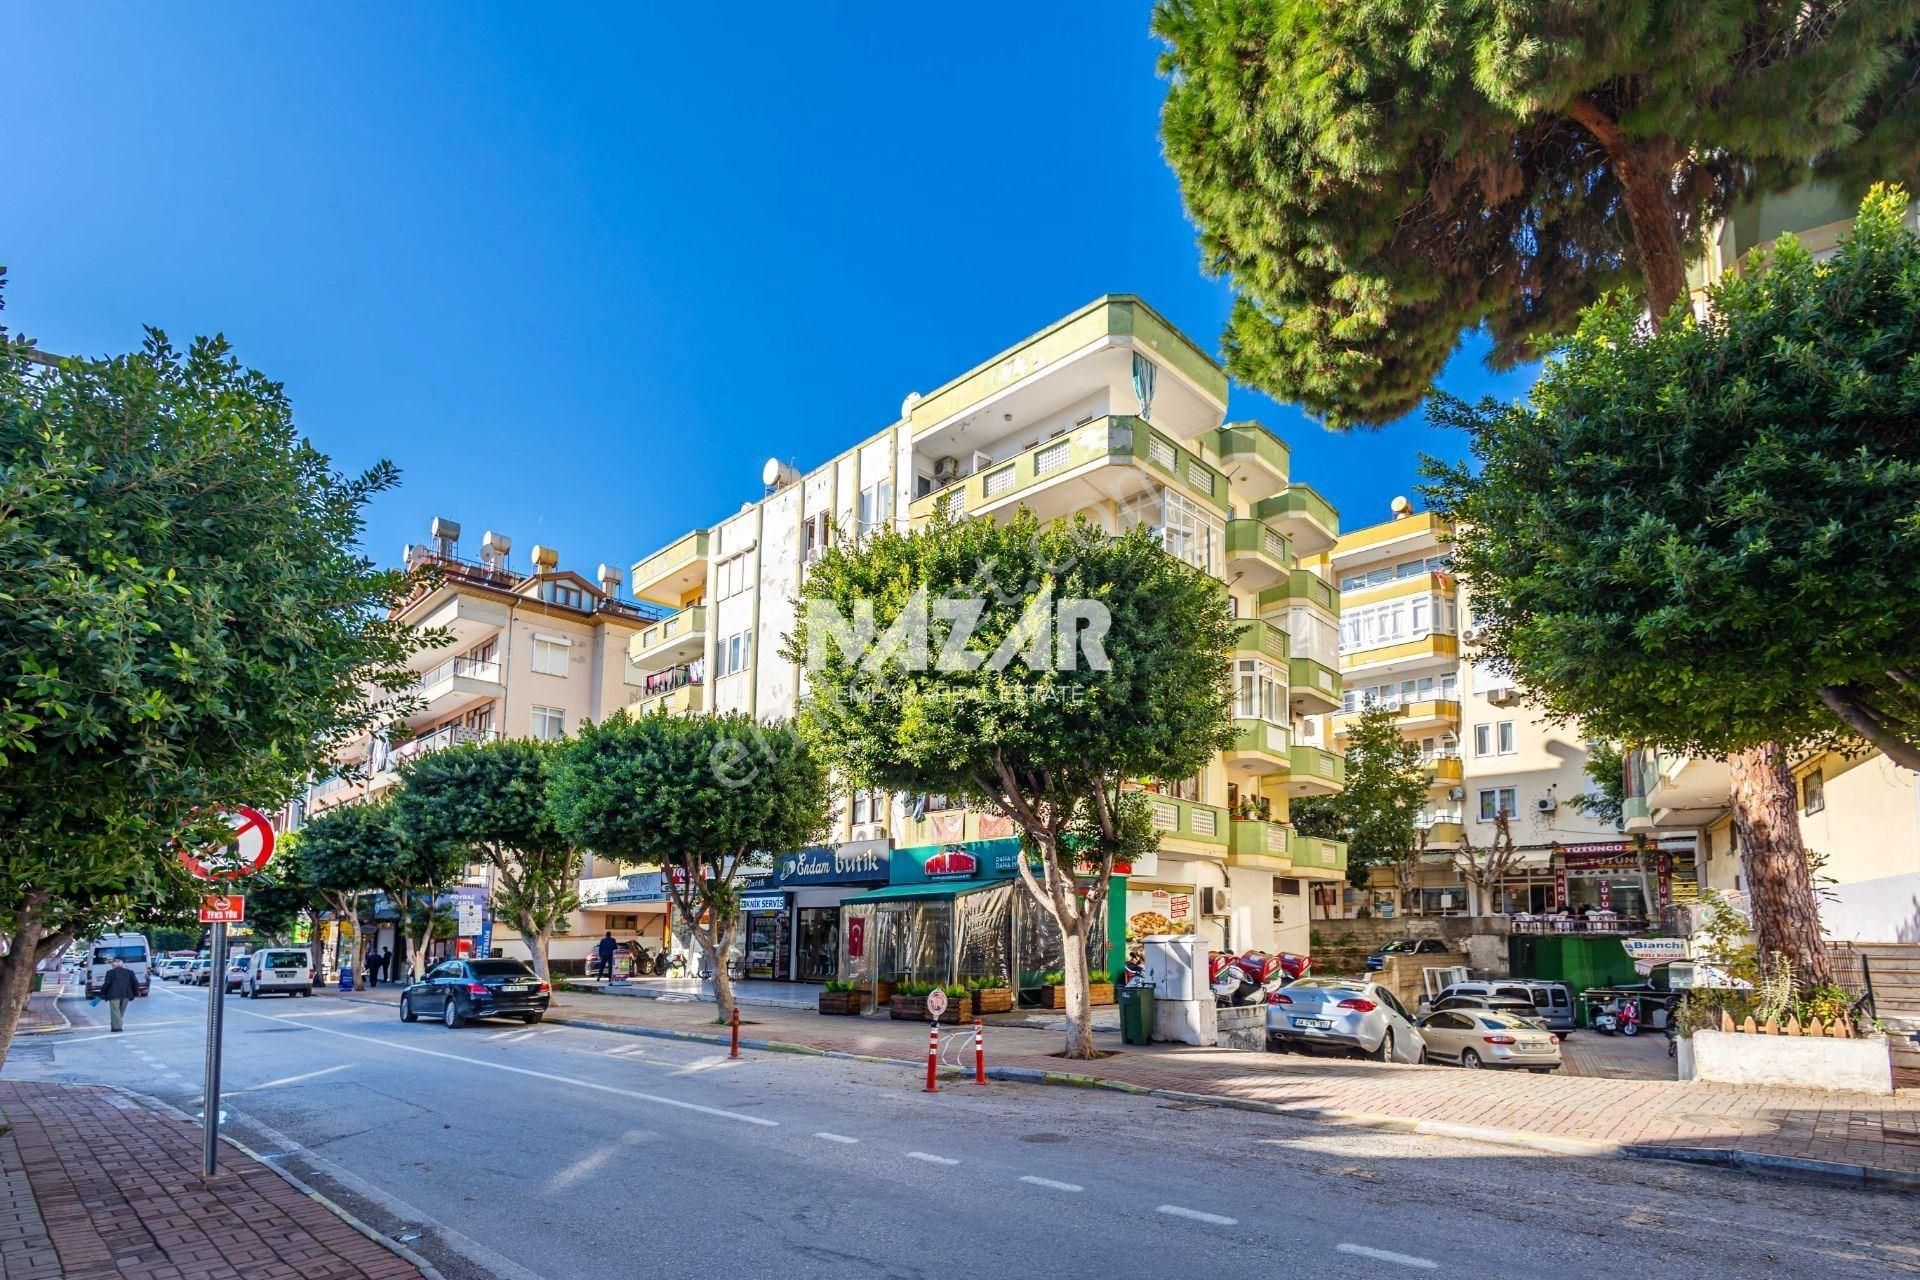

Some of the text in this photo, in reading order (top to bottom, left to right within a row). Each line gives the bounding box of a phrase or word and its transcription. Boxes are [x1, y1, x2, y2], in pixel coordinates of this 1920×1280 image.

[797, 848, 879, 876] Endam butik
[1634, 941, 1684, 949] Bianchi
